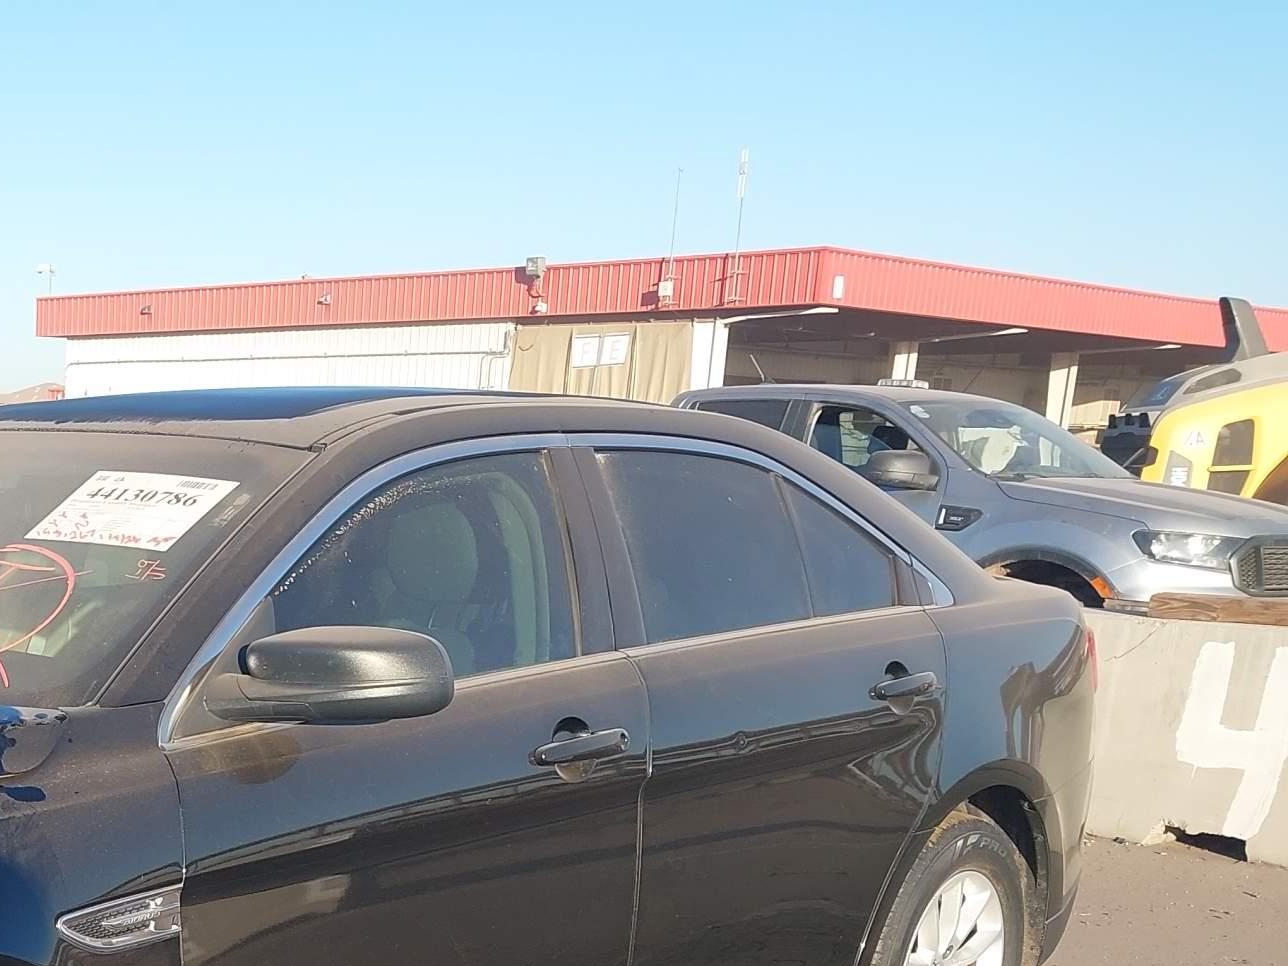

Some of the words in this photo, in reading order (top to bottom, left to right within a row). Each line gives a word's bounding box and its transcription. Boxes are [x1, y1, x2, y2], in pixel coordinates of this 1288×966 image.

[87, 487, 203, 507] 44130786
[1175, 641, 1288, 840] 4
[979, 836, 1008, 858] PRO
